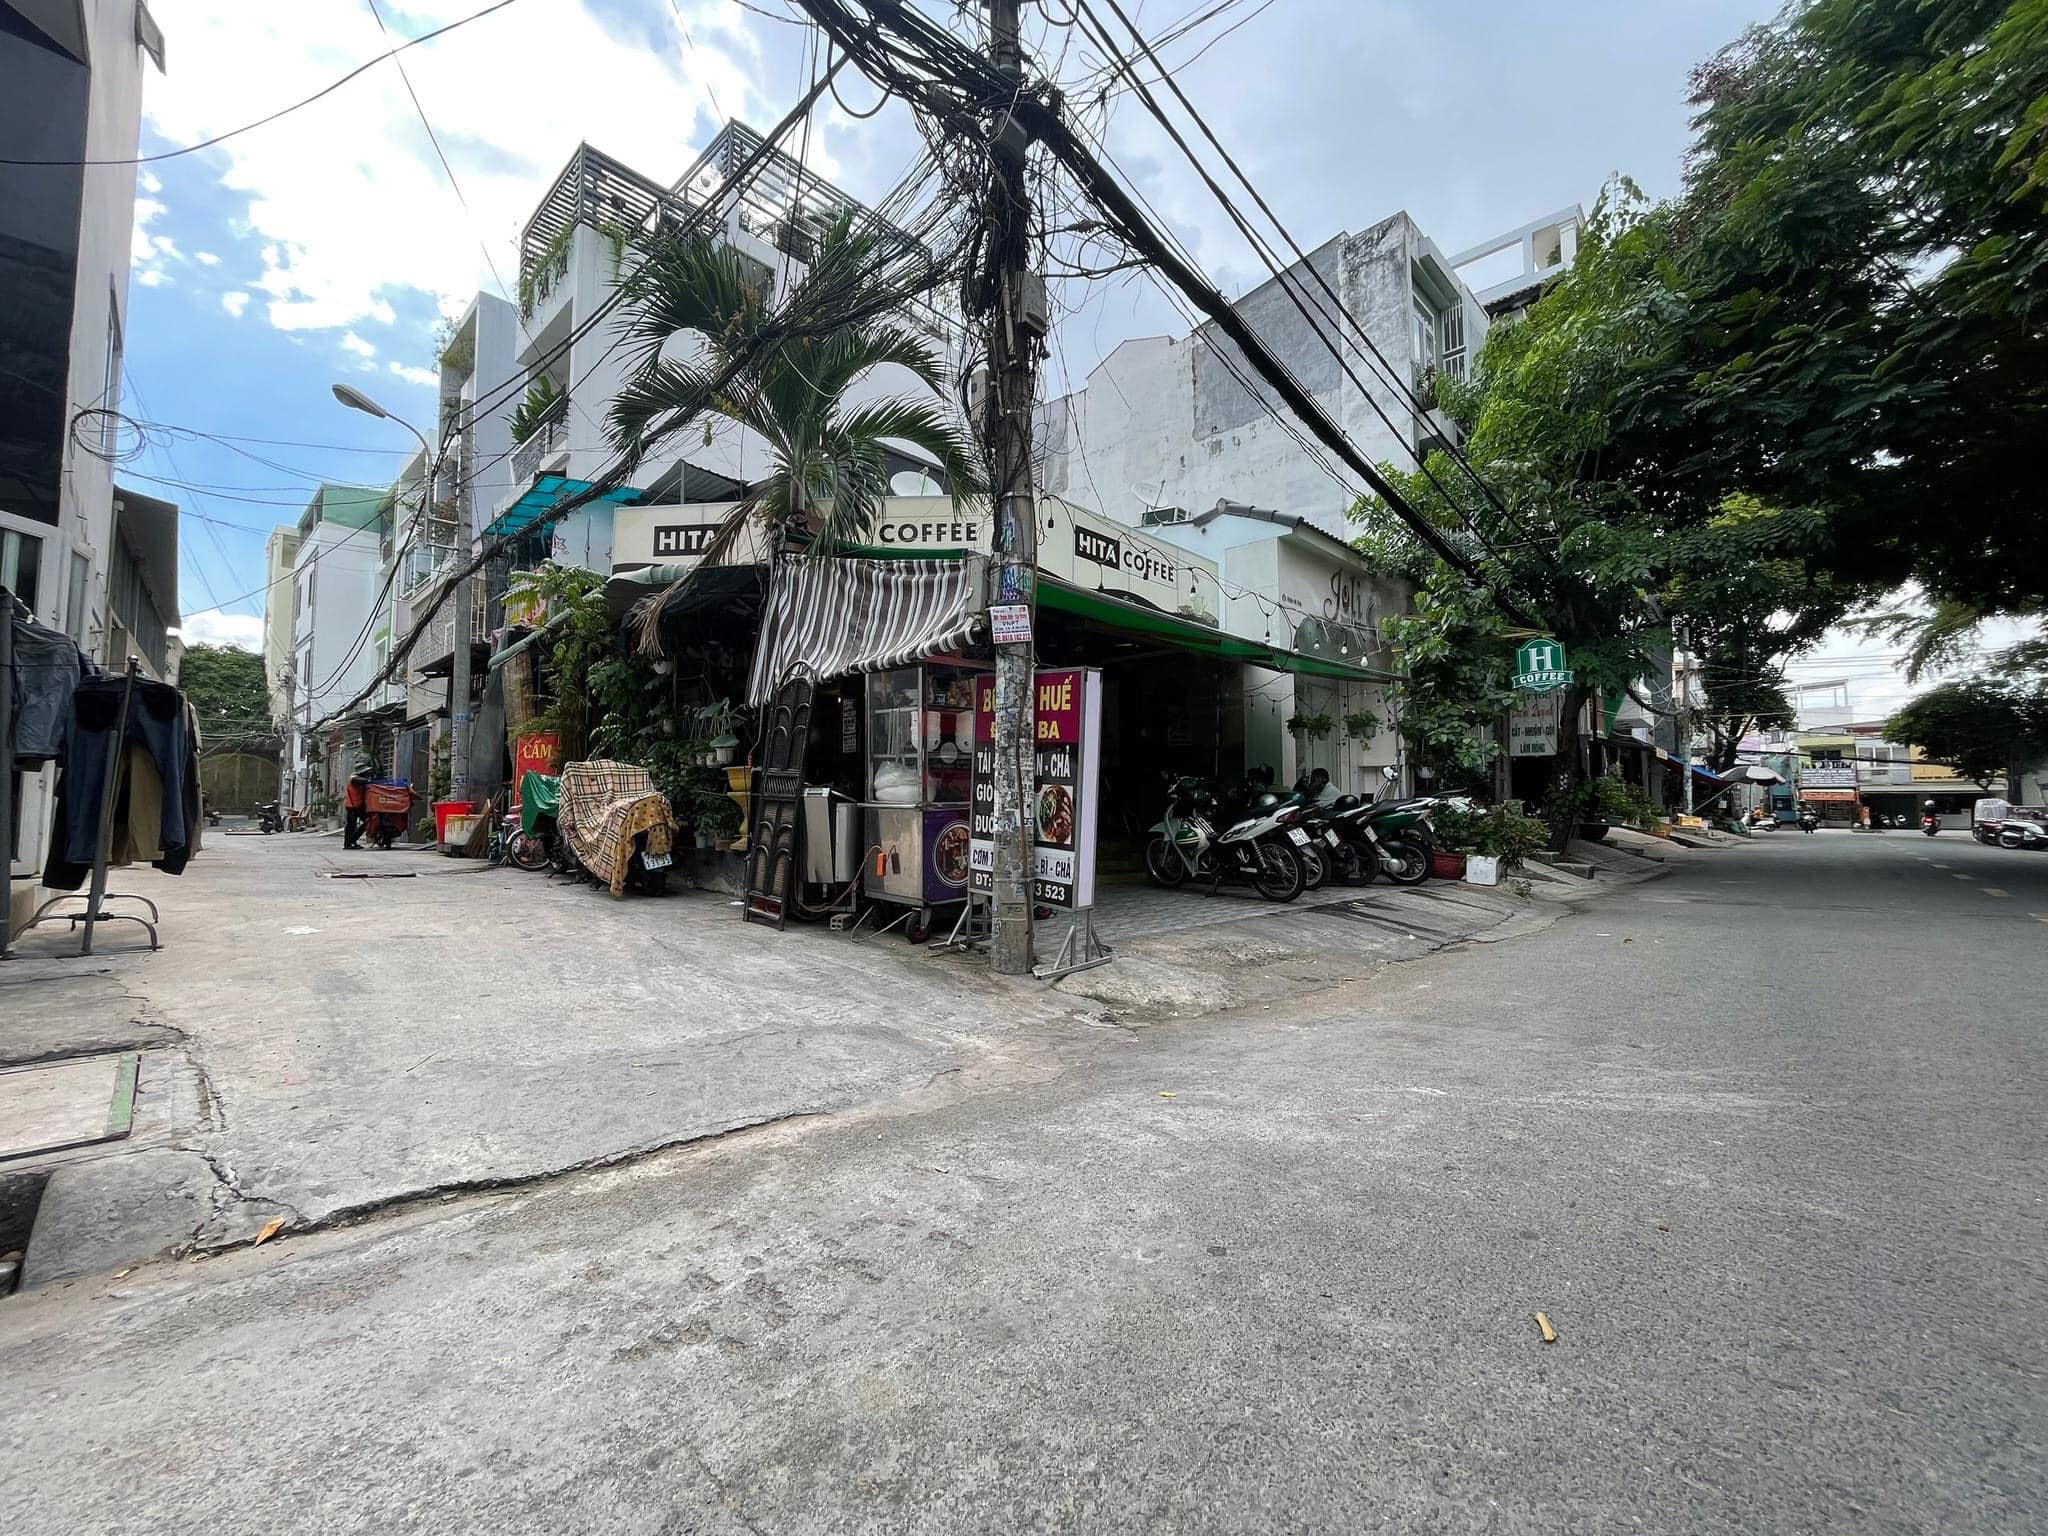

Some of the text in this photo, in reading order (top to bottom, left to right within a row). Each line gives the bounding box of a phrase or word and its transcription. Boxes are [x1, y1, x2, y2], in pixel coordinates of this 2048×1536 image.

[659, 522, 978, 551] HITA COFFEE
[1079, 532, 1175, 583] HITA COFFEE
[1528, 646, 1554, 671] H
[1039, 674, 1073, 711] HUẾ
[1519, 672, 1565, 684] COFFEE
[1038, 720, 1060, 739] BA
[977, 746, 991, 774] TÁI
[1050, 744, 1071, 778] CHẢ
[972, 848, 989, 866] CƠM
[1040, 855, 1049, 876] BÌ
[1055, 857, 1071, 879] CHẢ
[975, 872, 992, 888] ĐT:
[1044, 884, 1066, 901] 523
